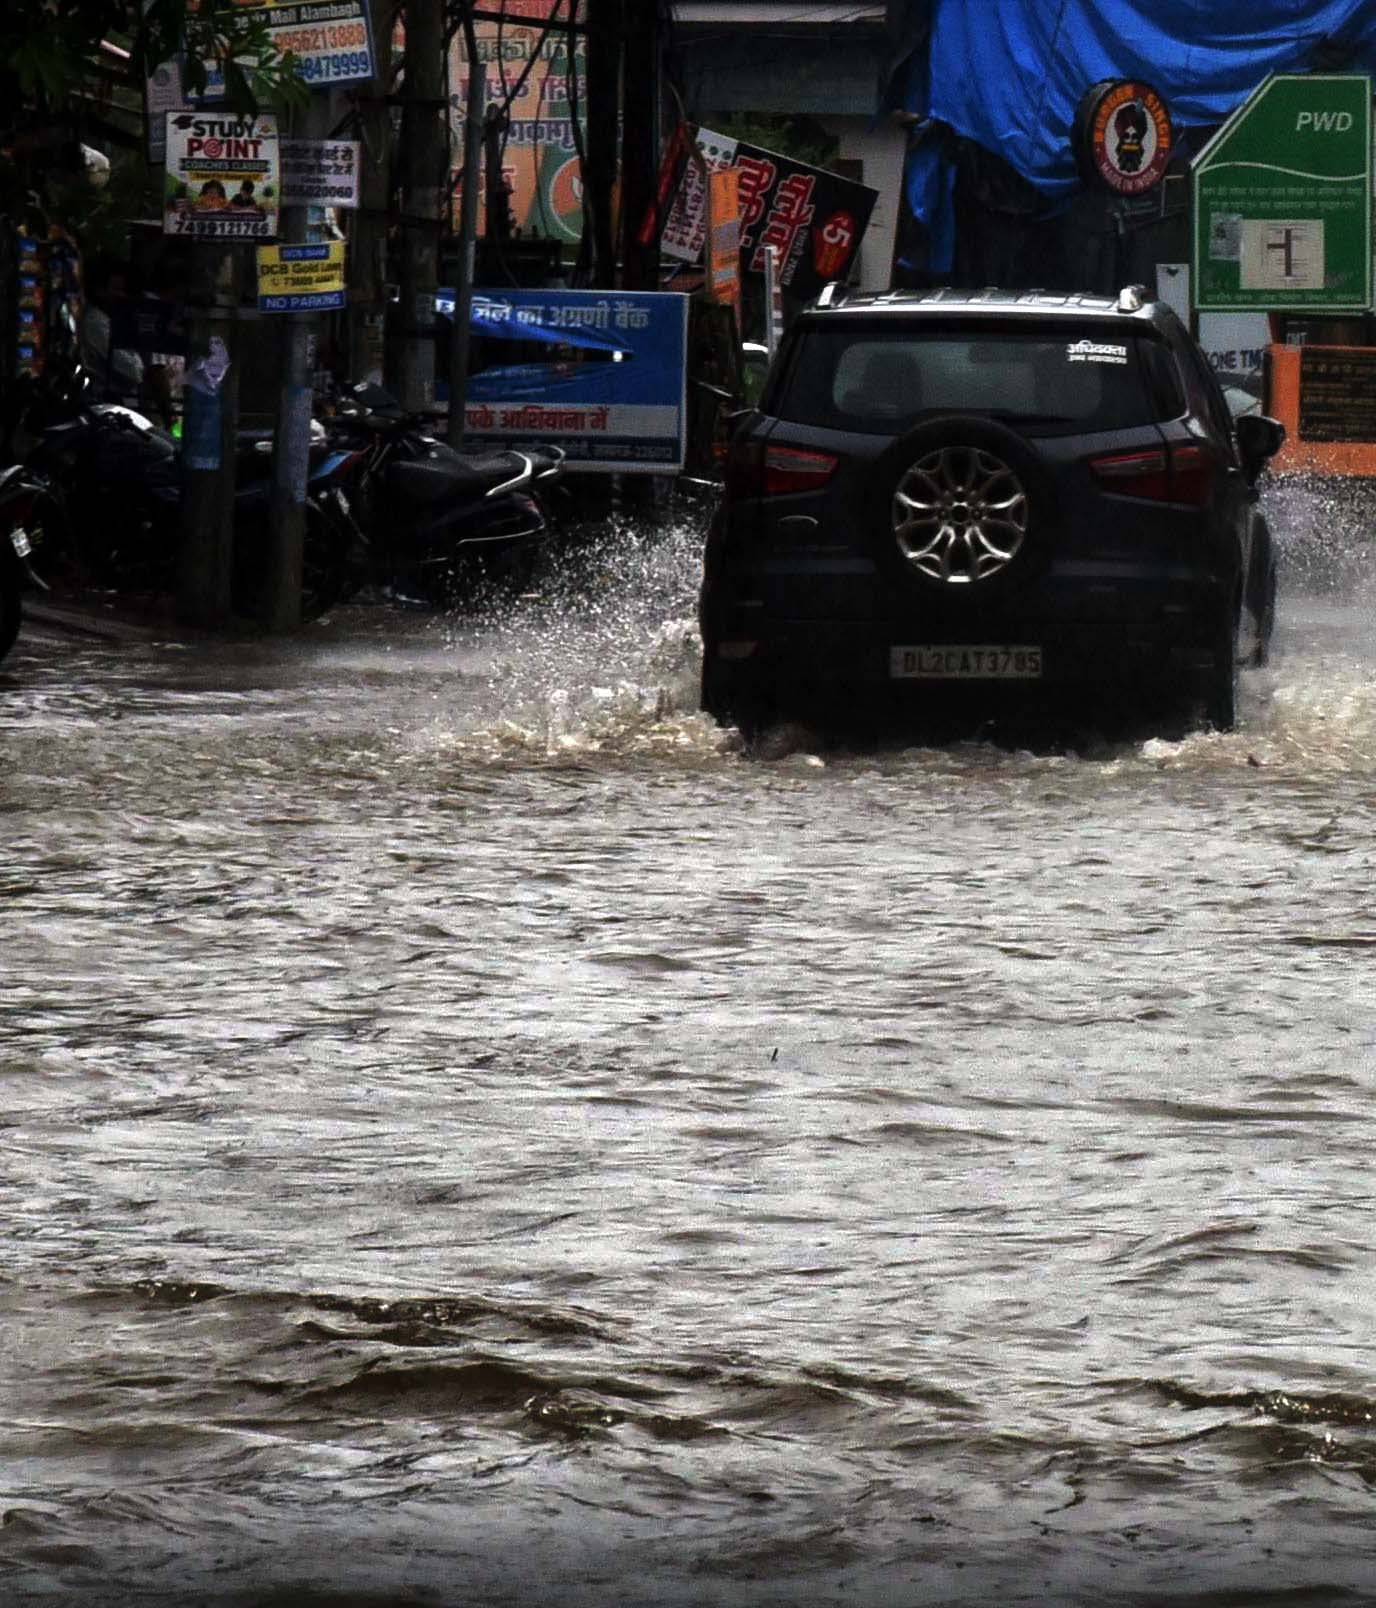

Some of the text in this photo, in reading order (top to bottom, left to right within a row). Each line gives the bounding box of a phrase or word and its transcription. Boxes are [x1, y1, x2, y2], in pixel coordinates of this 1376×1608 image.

[193, 118, 255, 137] STUDY
[1296, 112, 1354, 132] PWD
[188, 139, 262, 158] POINT
[266, 296, 287, 309] NO
